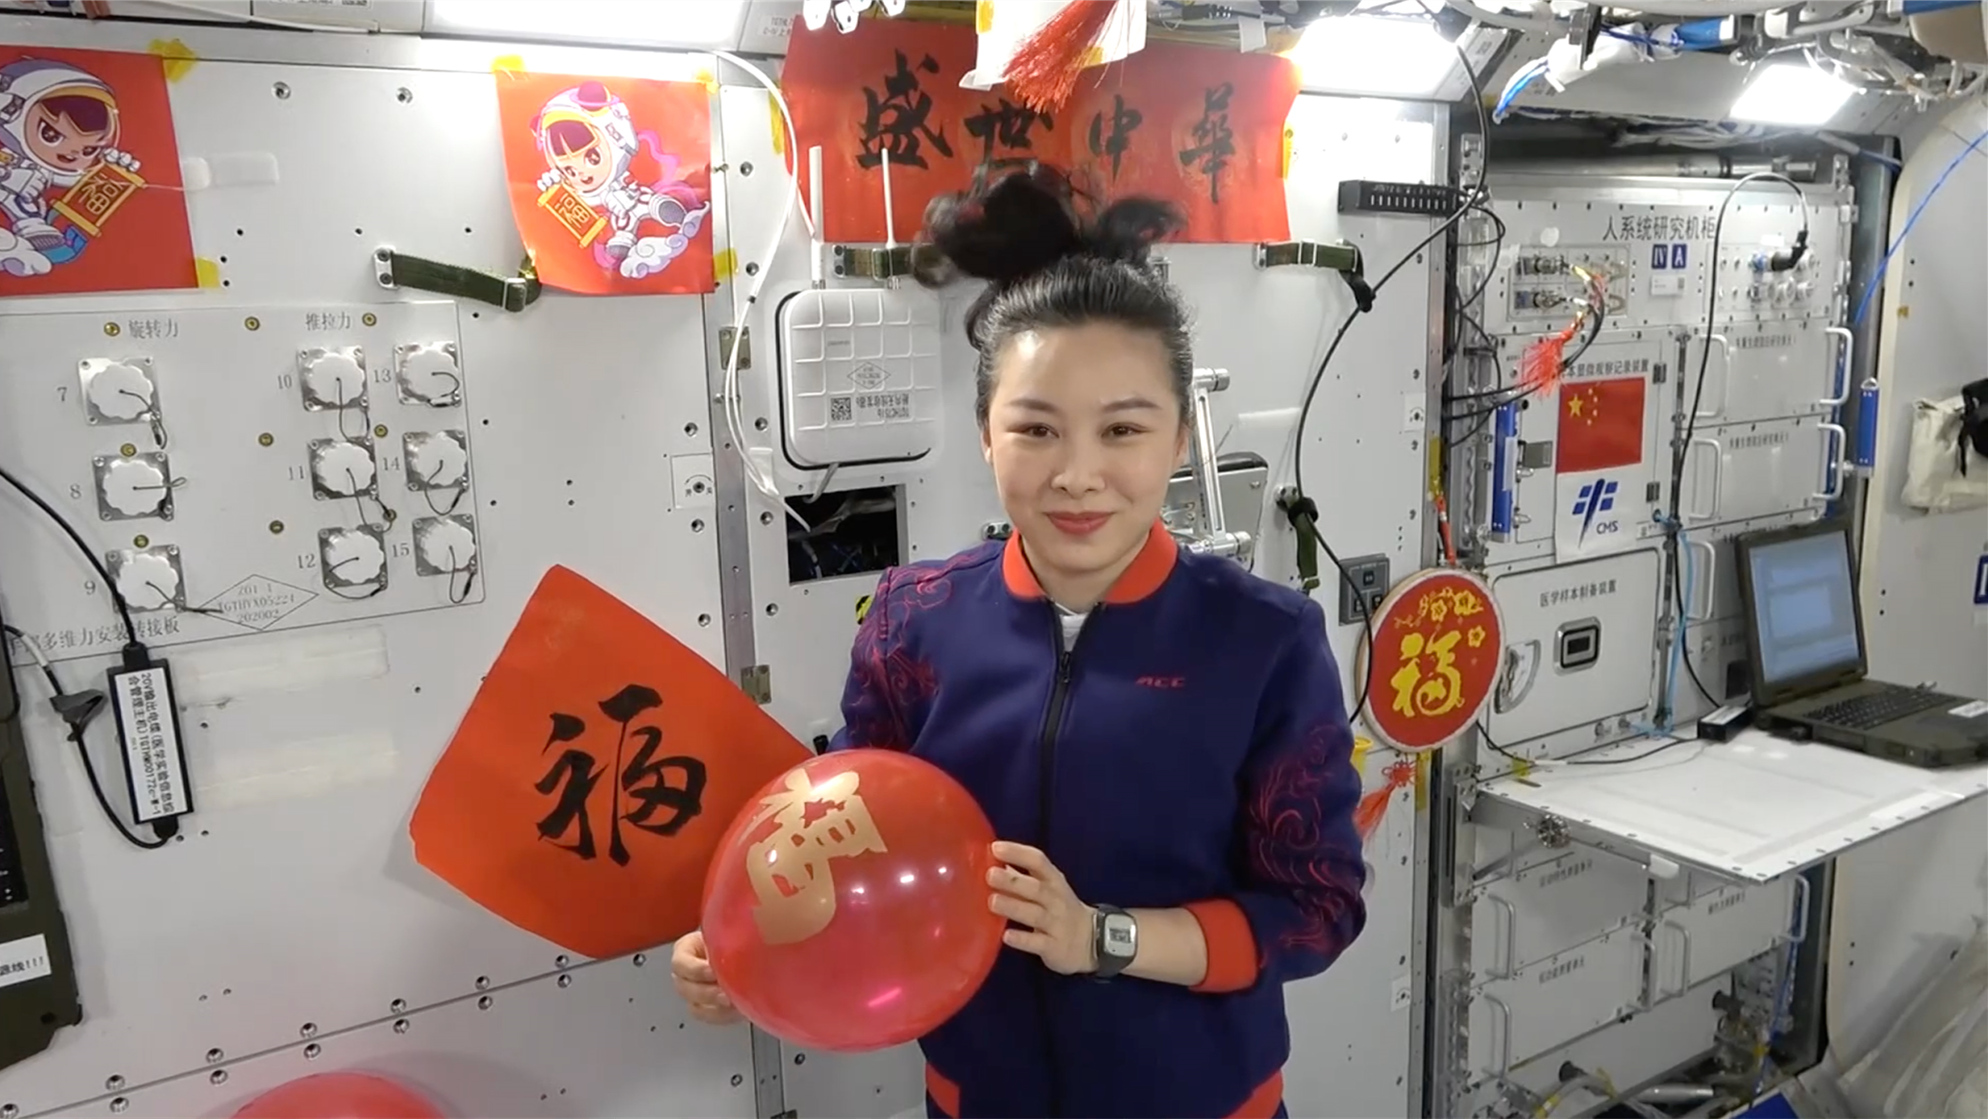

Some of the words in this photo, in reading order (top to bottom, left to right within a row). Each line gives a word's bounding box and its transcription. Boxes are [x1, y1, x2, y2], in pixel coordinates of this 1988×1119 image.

[79, 172, 131, 215] 福
[554, 192, 591, 229] 福
[1602, 215, 1716, 241] 人系统研究机柜
[1674, 246, 1684, 267] A
[128, 319, 179, 339] 旋转力
[305, 312, 352, 332] 推拉力
[374, 369, 391, 384] 13
[1562, 359, 1649, 379] 本显微观察记录装置
[277, 374, 292, 390] 10
[57, 387, 68, 402] 7
[288, 465, 304, 480] 11
[382, 456, 400, 472] 14
[69, 484, 81, 499] 8
[1596, 521, 1619, 534] CMS
[392, 542, 409, 558] 15
[298, 554, 315, 569] 12
[85, 581, 96, 595] 9
[1540, 579, 1617, 608] 医学样本制备装置
[1390, 631, 1466, 718] 福
[534, 683, 708, 867] 福
